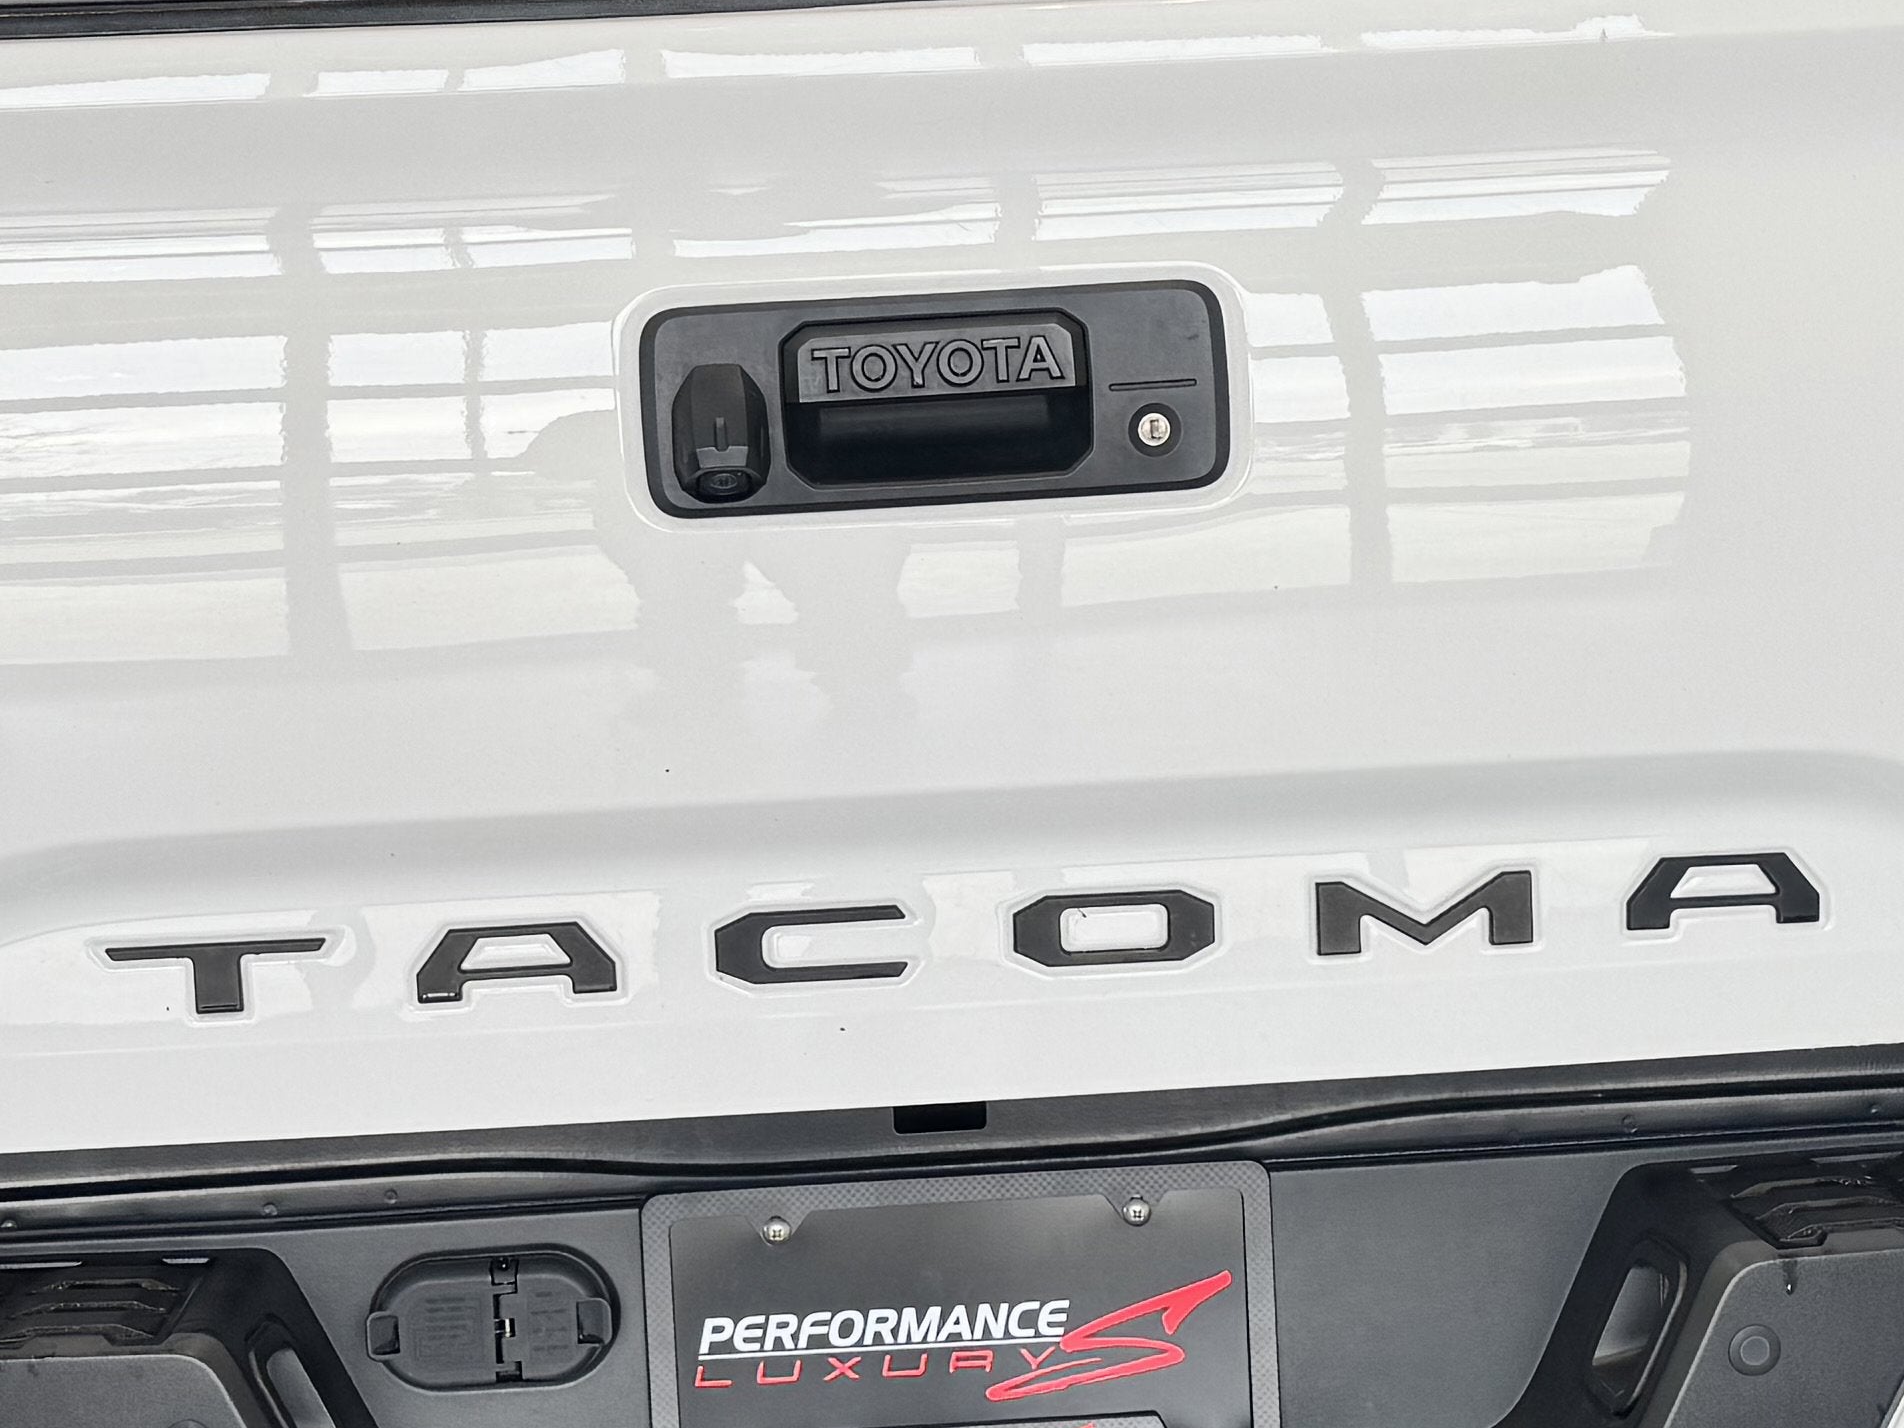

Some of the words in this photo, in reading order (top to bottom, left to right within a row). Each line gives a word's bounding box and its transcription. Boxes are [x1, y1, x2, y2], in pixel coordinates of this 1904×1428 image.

[810, 333, 1066, 394] TOYOTA
[103, 851, 1822, 1014] TACOMA
[698, 1299, 1070, 1355] PERFORMANCE
[695, 1346, 1057, 1388] LUXURY
